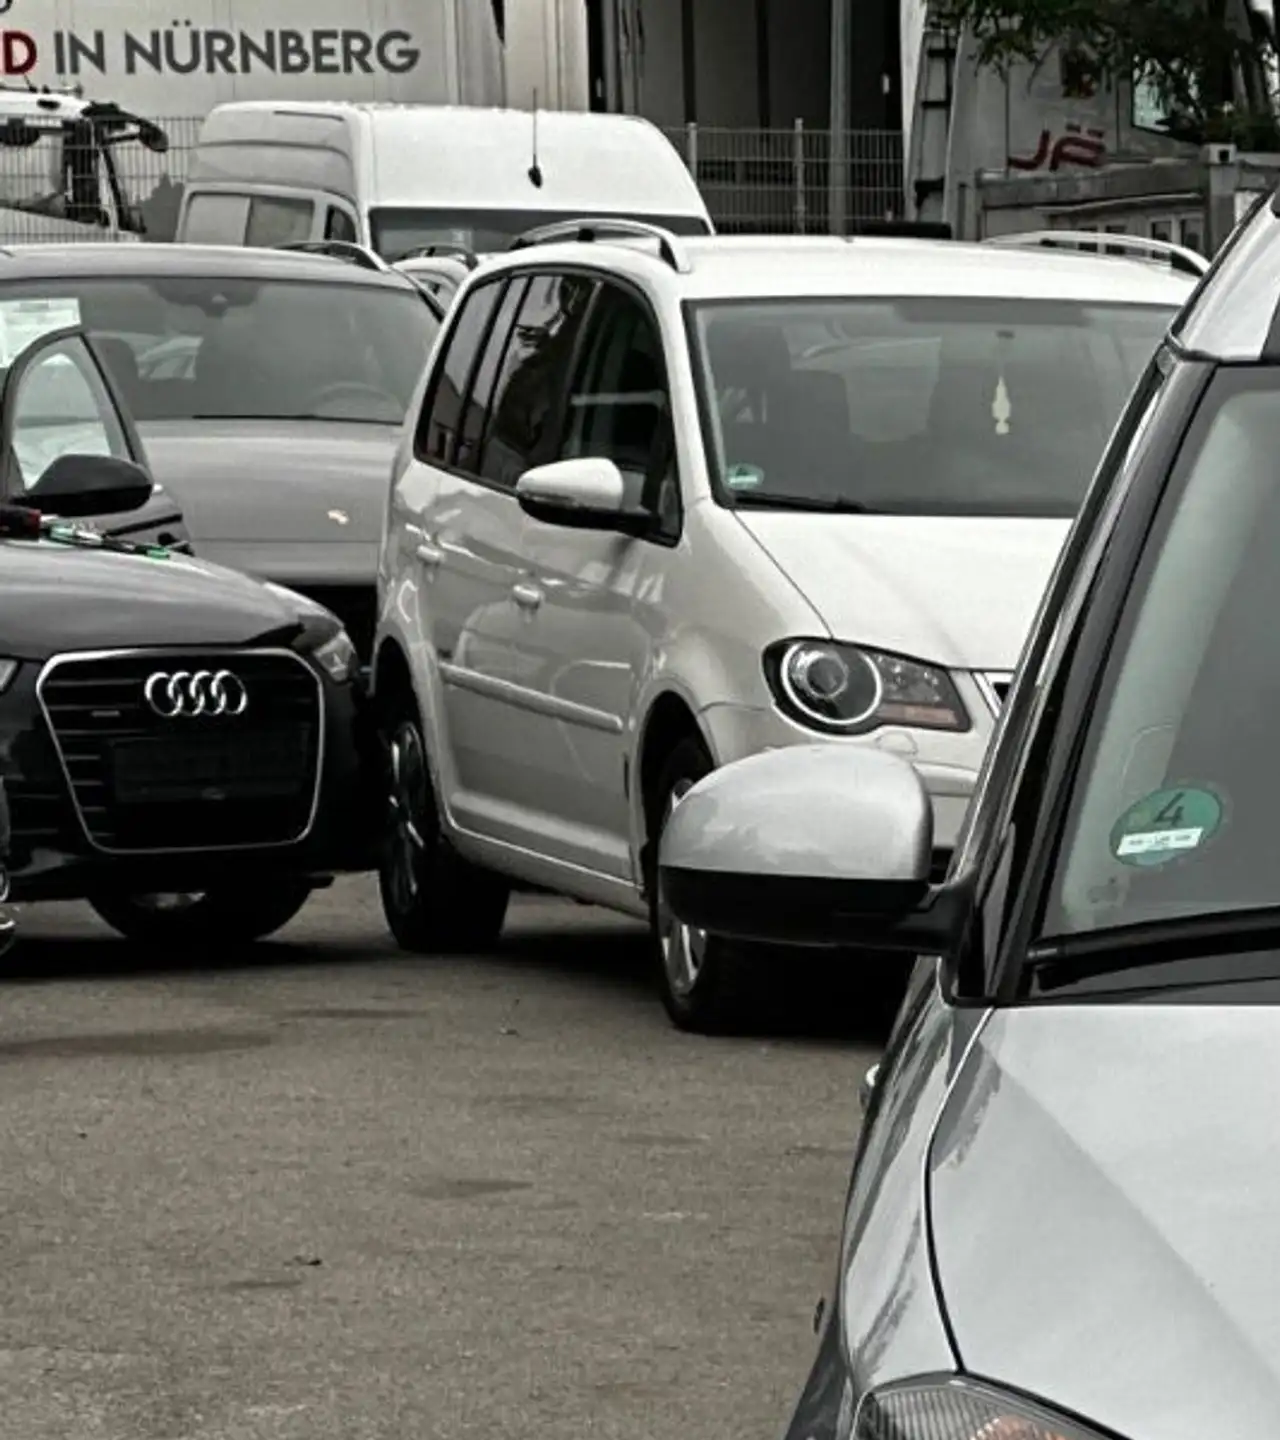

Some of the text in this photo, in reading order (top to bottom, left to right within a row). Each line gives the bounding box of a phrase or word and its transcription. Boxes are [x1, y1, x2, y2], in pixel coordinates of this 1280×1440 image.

[54, 30, 106, 75] IN
[124, 19, 421, 75] NÜRNBERG
[1153, 791, 1185, 827] 4
